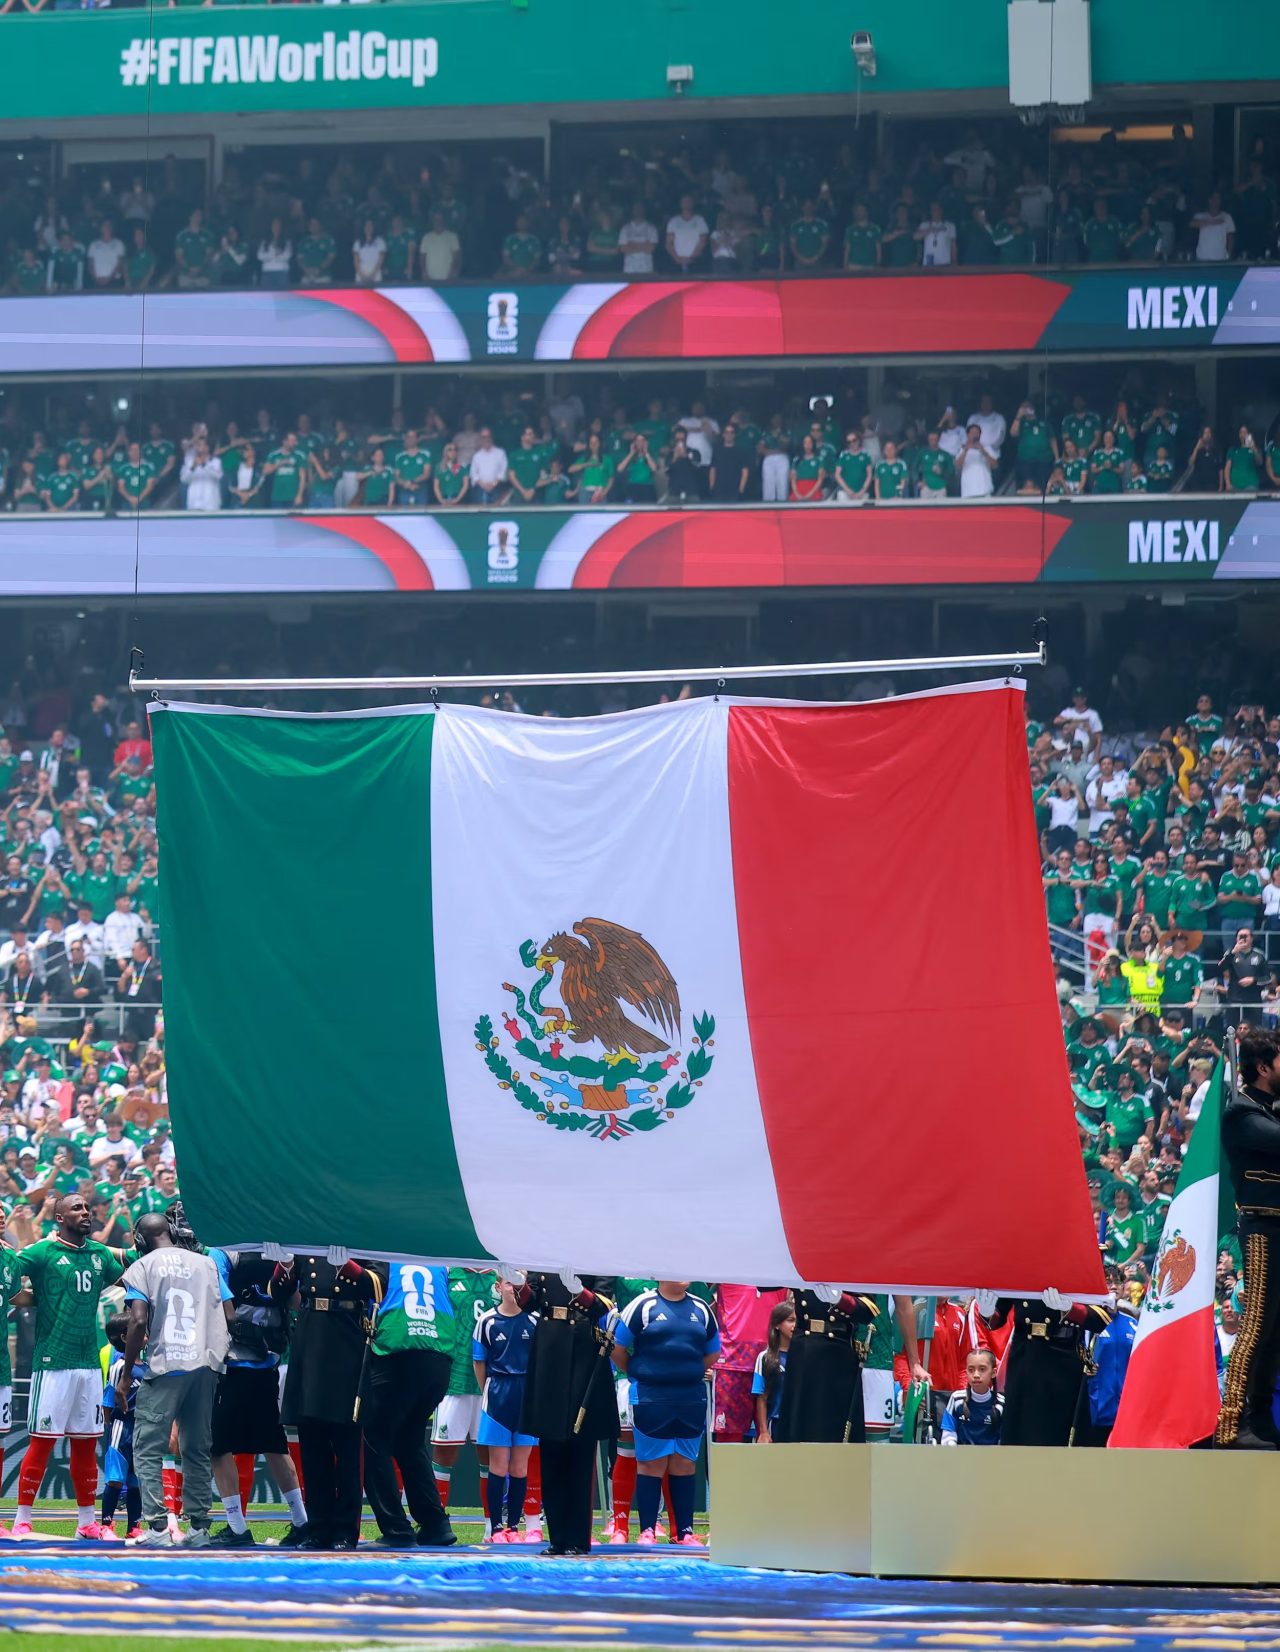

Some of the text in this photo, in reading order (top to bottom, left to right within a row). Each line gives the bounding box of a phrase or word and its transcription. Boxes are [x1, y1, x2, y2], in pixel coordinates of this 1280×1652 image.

[119, 30, 439, 87] #FIFAWorldCup
[161, 1254, 182, 1265] HB
[158, 1265, 191, 1280] 0425
[74, 1270, 92, 1293] 16
[407, 1327, 439, 1339] 2026
[166, 1351, 198, 1361] 2026
